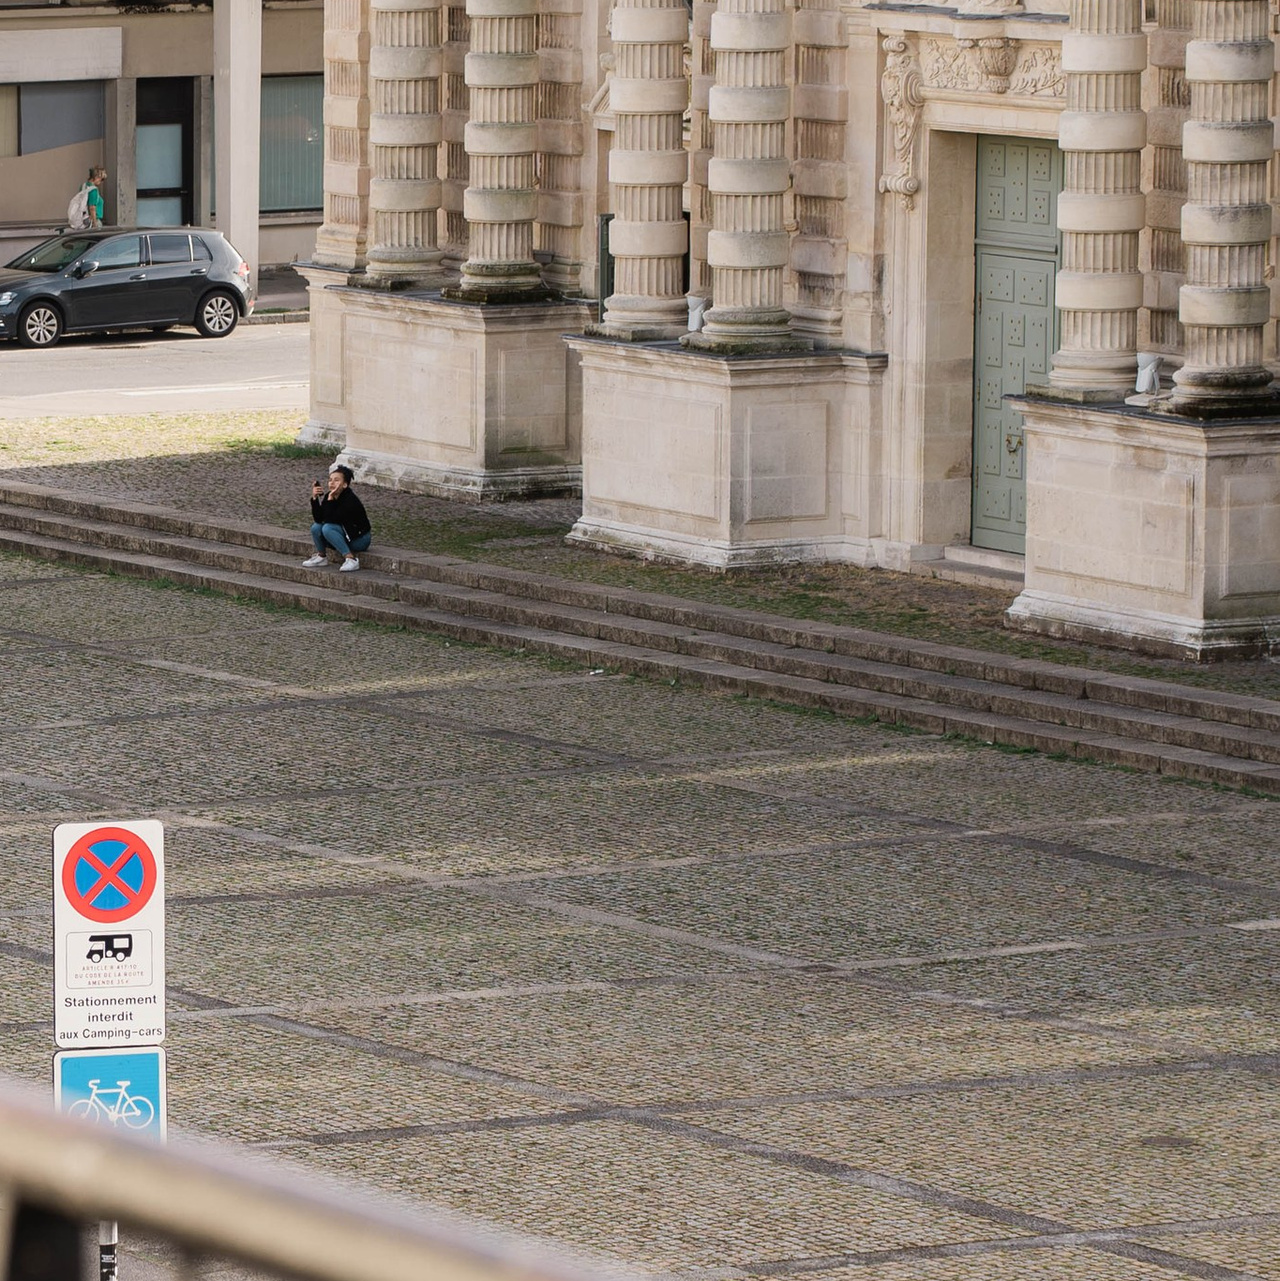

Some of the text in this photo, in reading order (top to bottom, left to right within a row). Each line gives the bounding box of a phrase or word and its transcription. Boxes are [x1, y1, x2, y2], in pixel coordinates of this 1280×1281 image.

[64, 995, 157, 1007] Stationnement
[88, 1011, 133, 1022] interdit
[59, 1027, 162, 1039] aux Camping-cars
